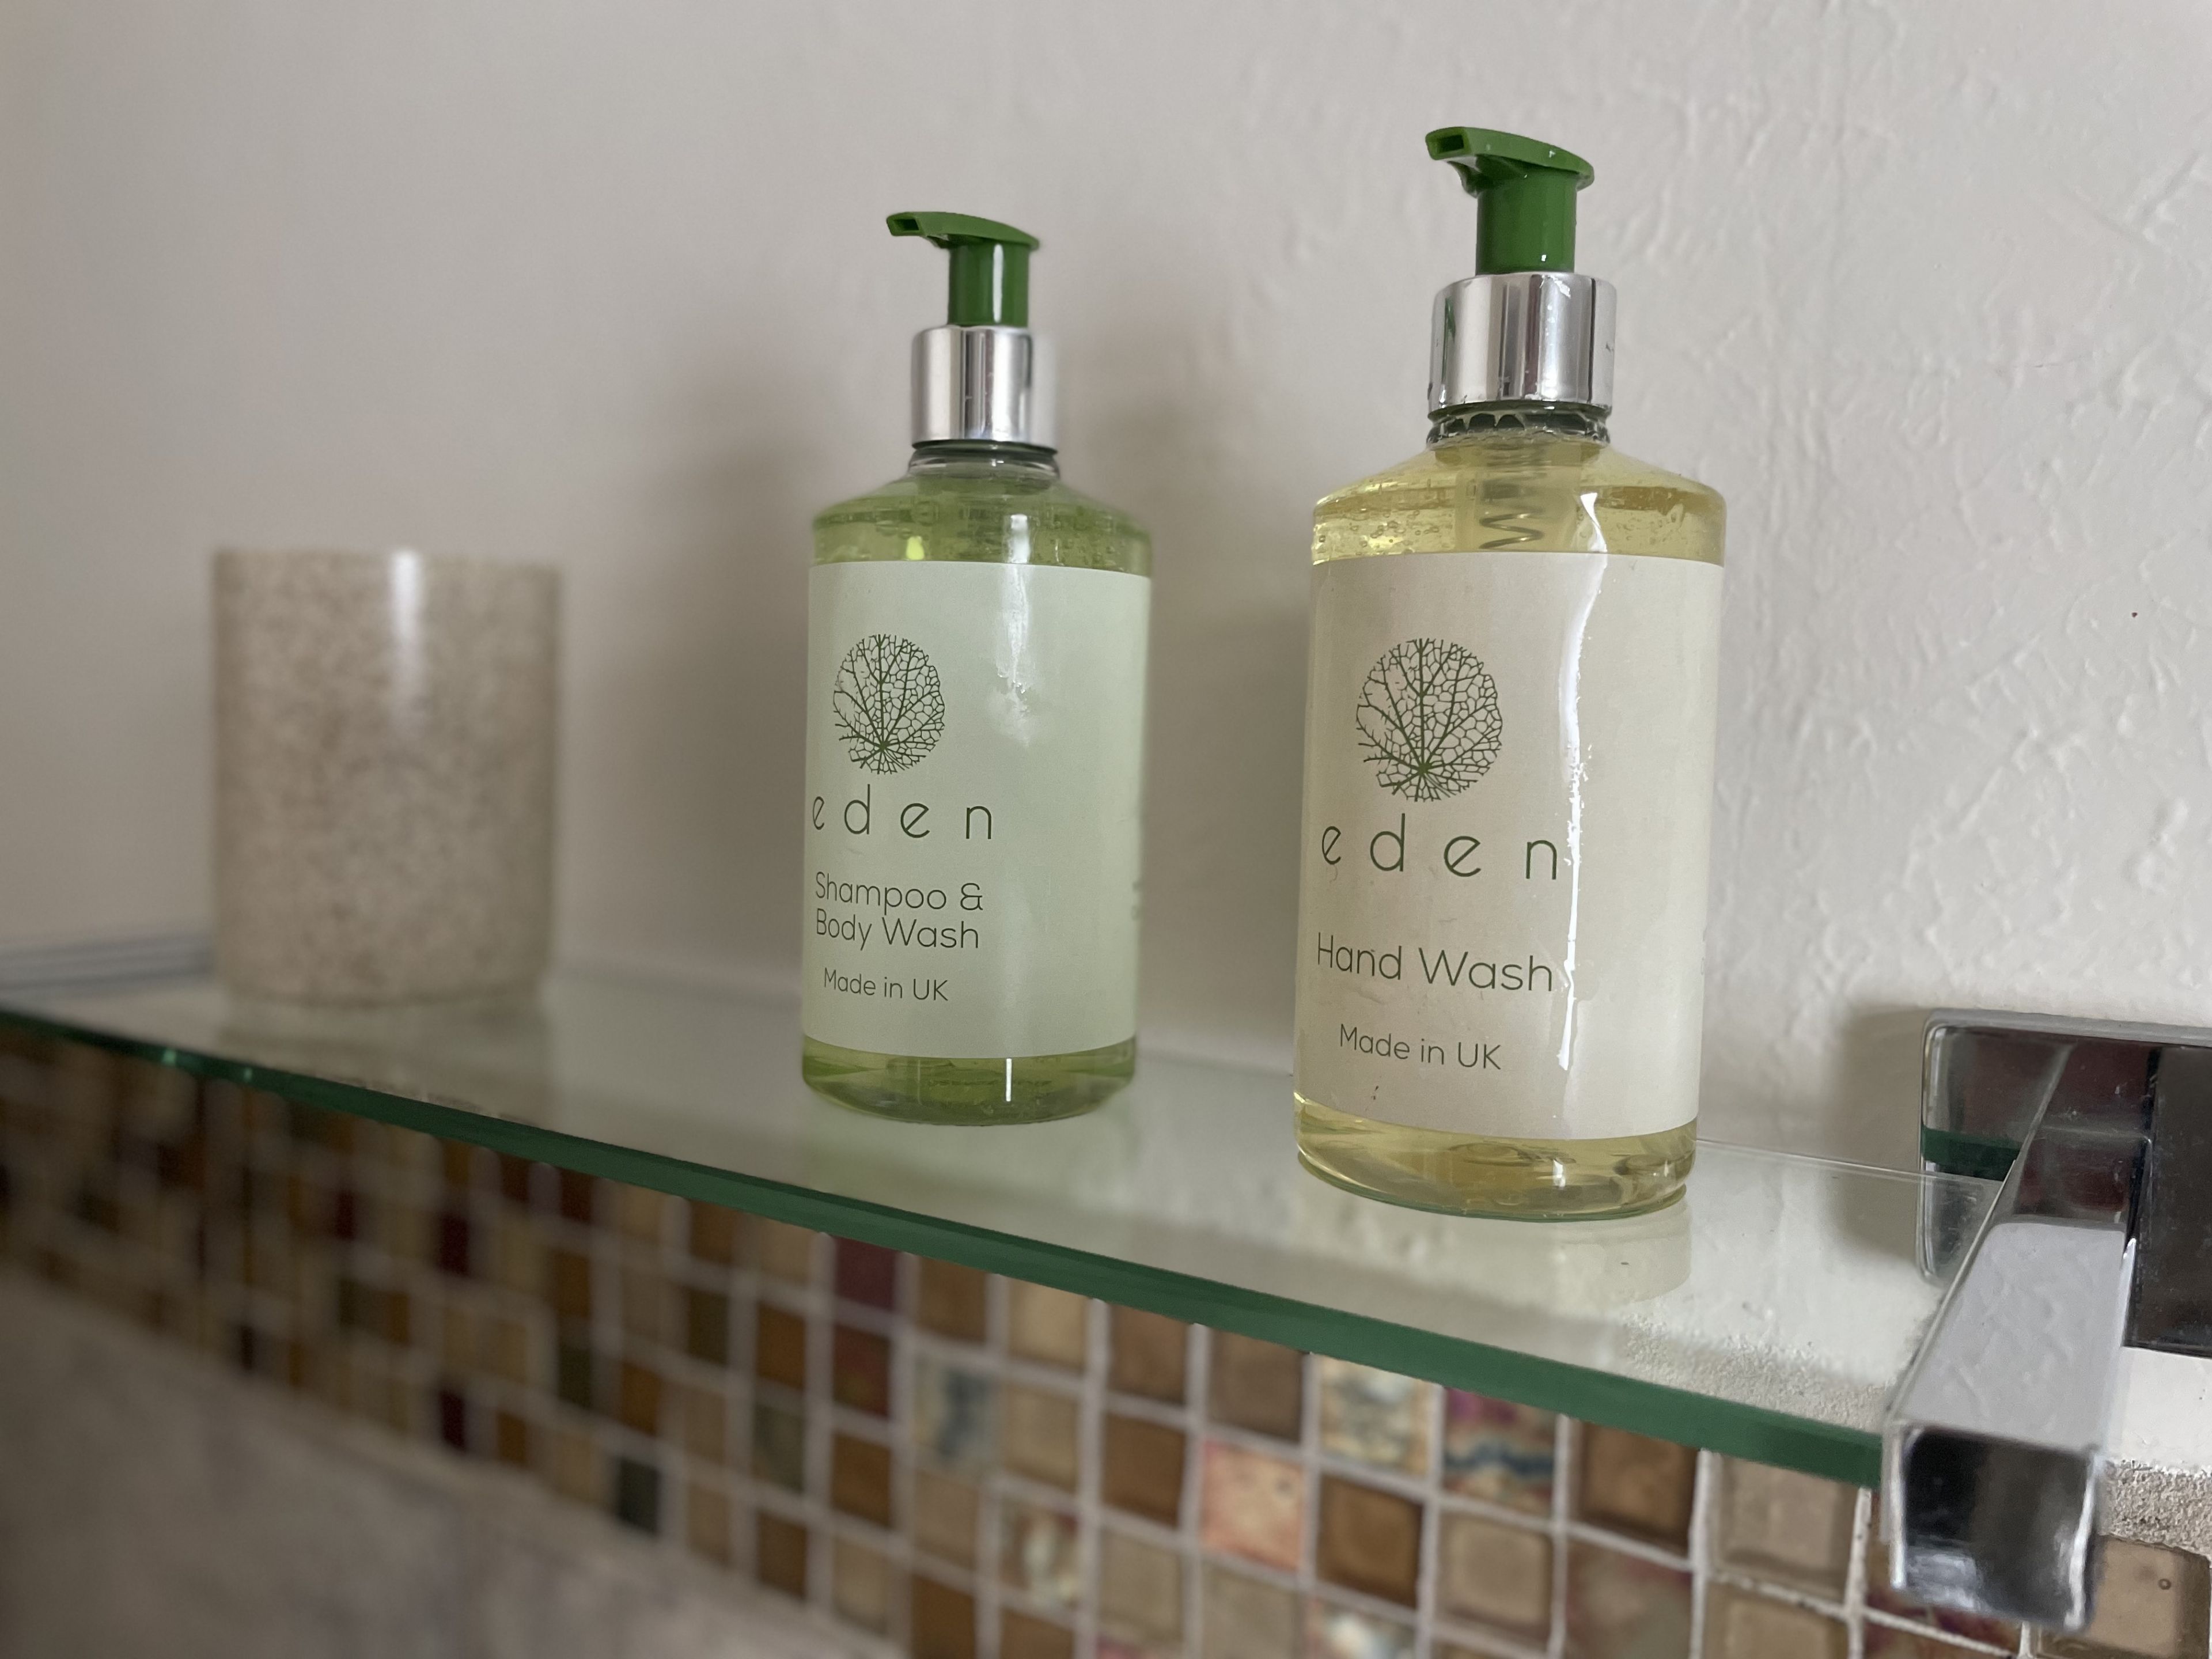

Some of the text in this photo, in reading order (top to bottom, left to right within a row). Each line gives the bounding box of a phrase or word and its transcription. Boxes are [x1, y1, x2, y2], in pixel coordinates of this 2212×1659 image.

[812, 783, 992, 840] eden
[1321, 812, 1558, 881] eden
[815, 871, 984, 916] Shampoo &
[816, 907, 979, 952] Body Wash
[824, 967, 949, 1001] Made in UK
[1317, 931, 1552, 992] Hand Wash
[1340, 1023, 1502, 1070] Made in UK
